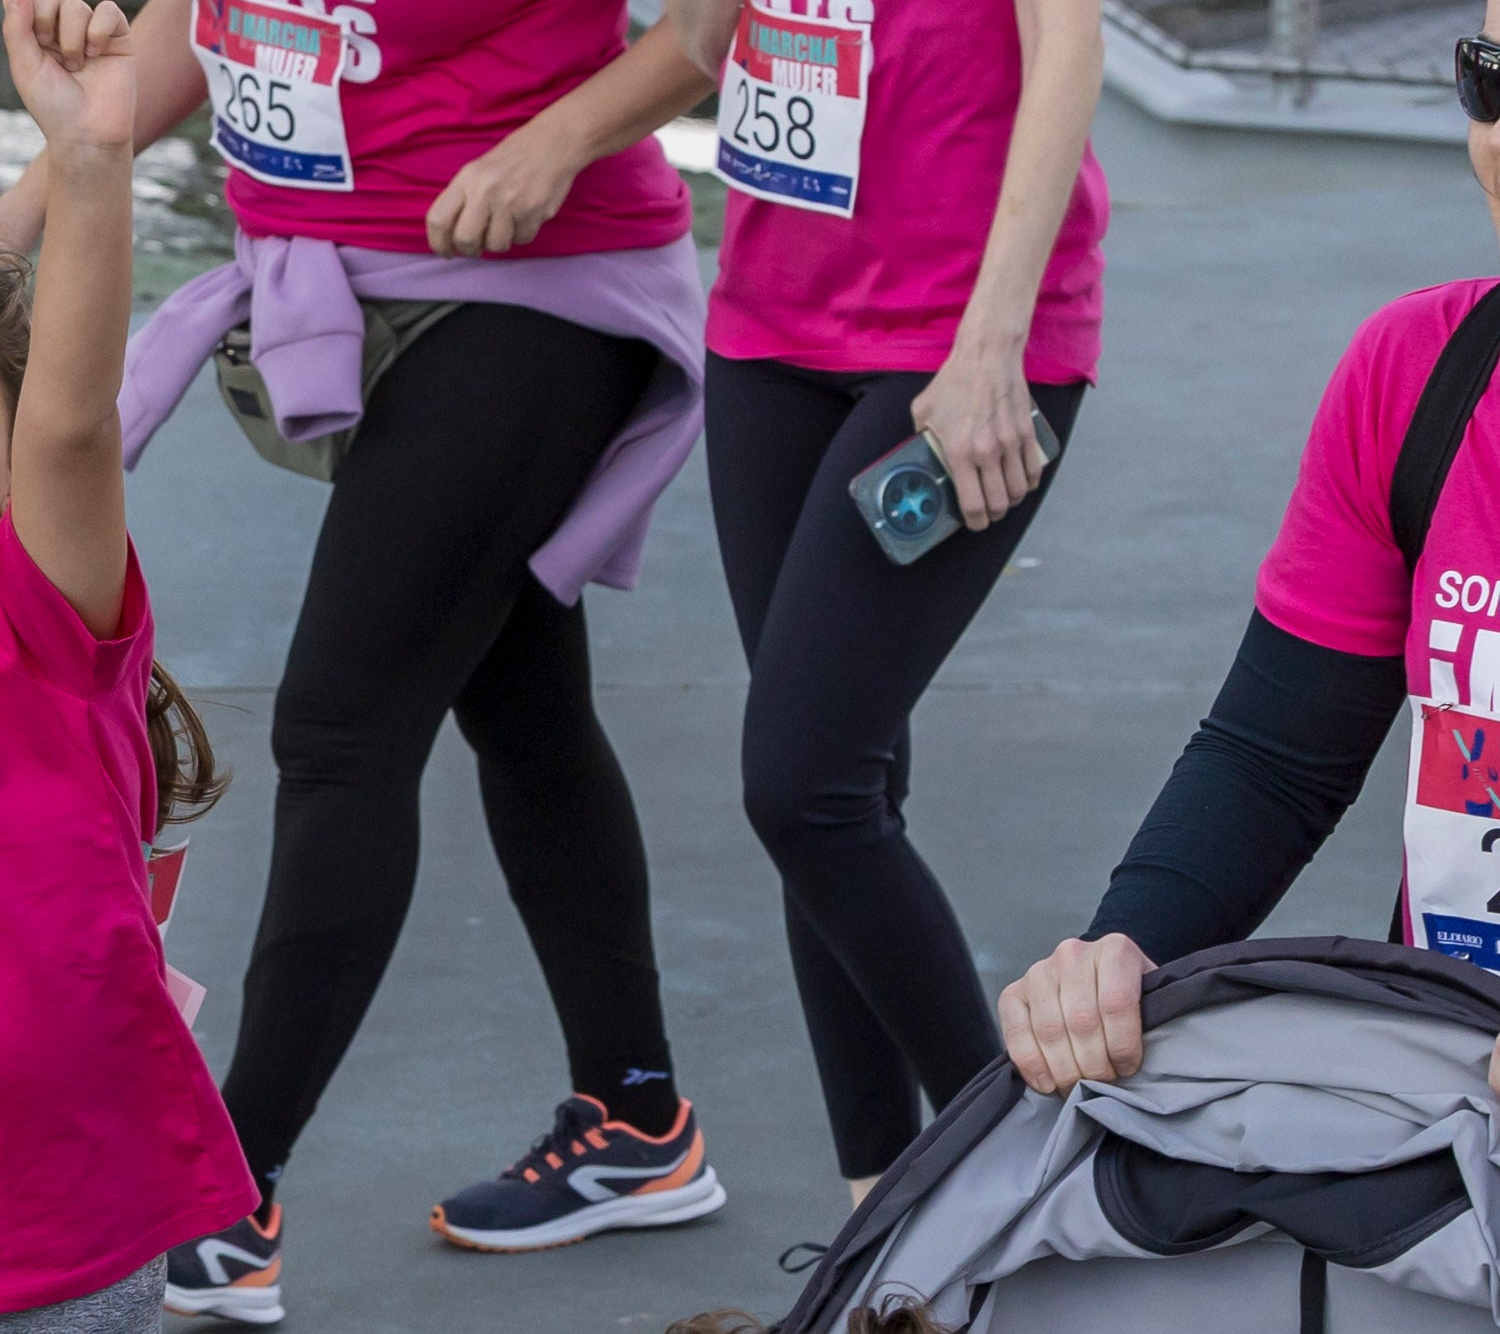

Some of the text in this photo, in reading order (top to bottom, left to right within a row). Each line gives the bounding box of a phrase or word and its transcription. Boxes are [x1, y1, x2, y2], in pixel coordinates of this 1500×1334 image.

[242, 13, 321, 55] MARCHA
[758, 26, 838, 66] MARCHA
[255, 44, 318, 82] MUJER
[771, 57, 838, 96] MUJER
[221, 63, 295, 141] 265
[734, 78, 815, 160] 258
